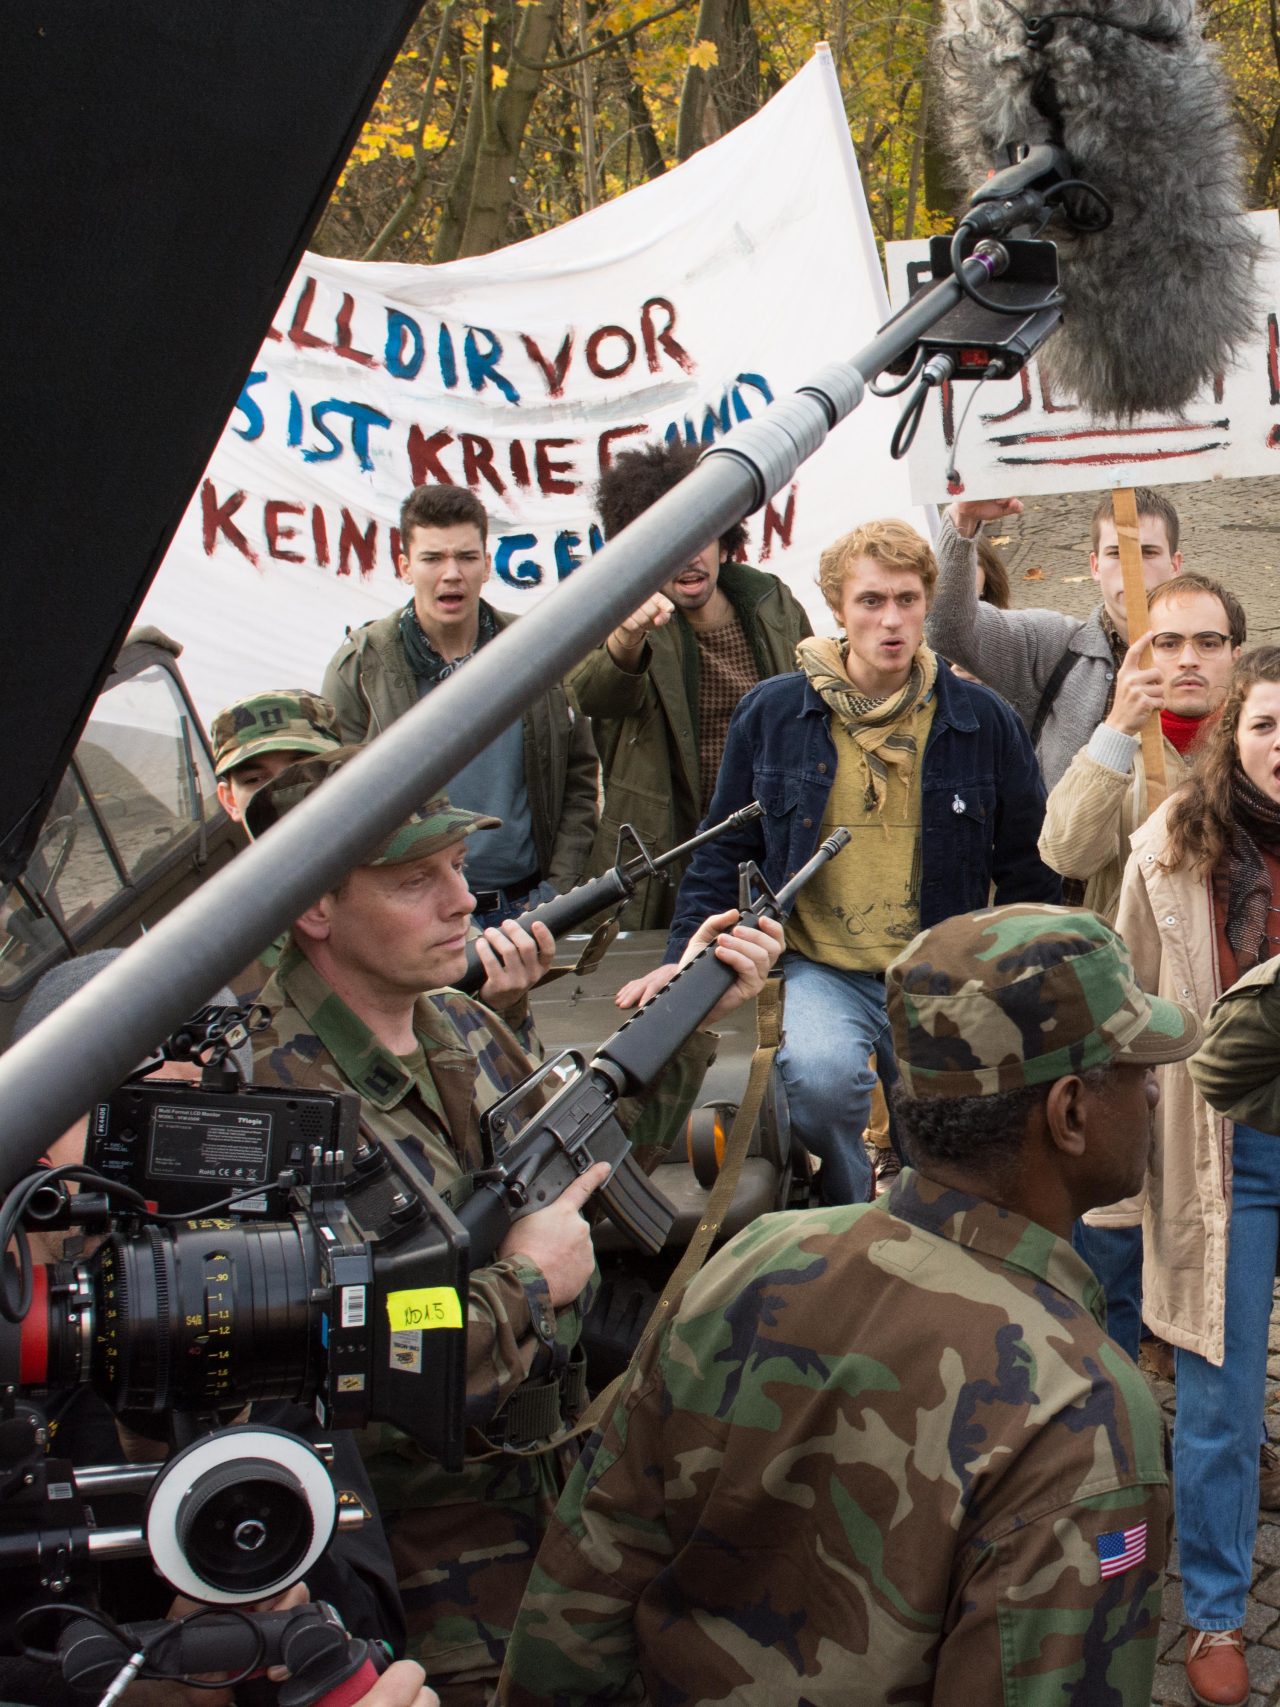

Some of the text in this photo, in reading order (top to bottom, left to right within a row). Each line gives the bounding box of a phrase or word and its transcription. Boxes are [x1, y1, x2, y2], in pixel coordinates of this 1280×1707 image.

[264, 276, 698, 407] LL DIR VOR
[287, 390, 392, 472] IST
